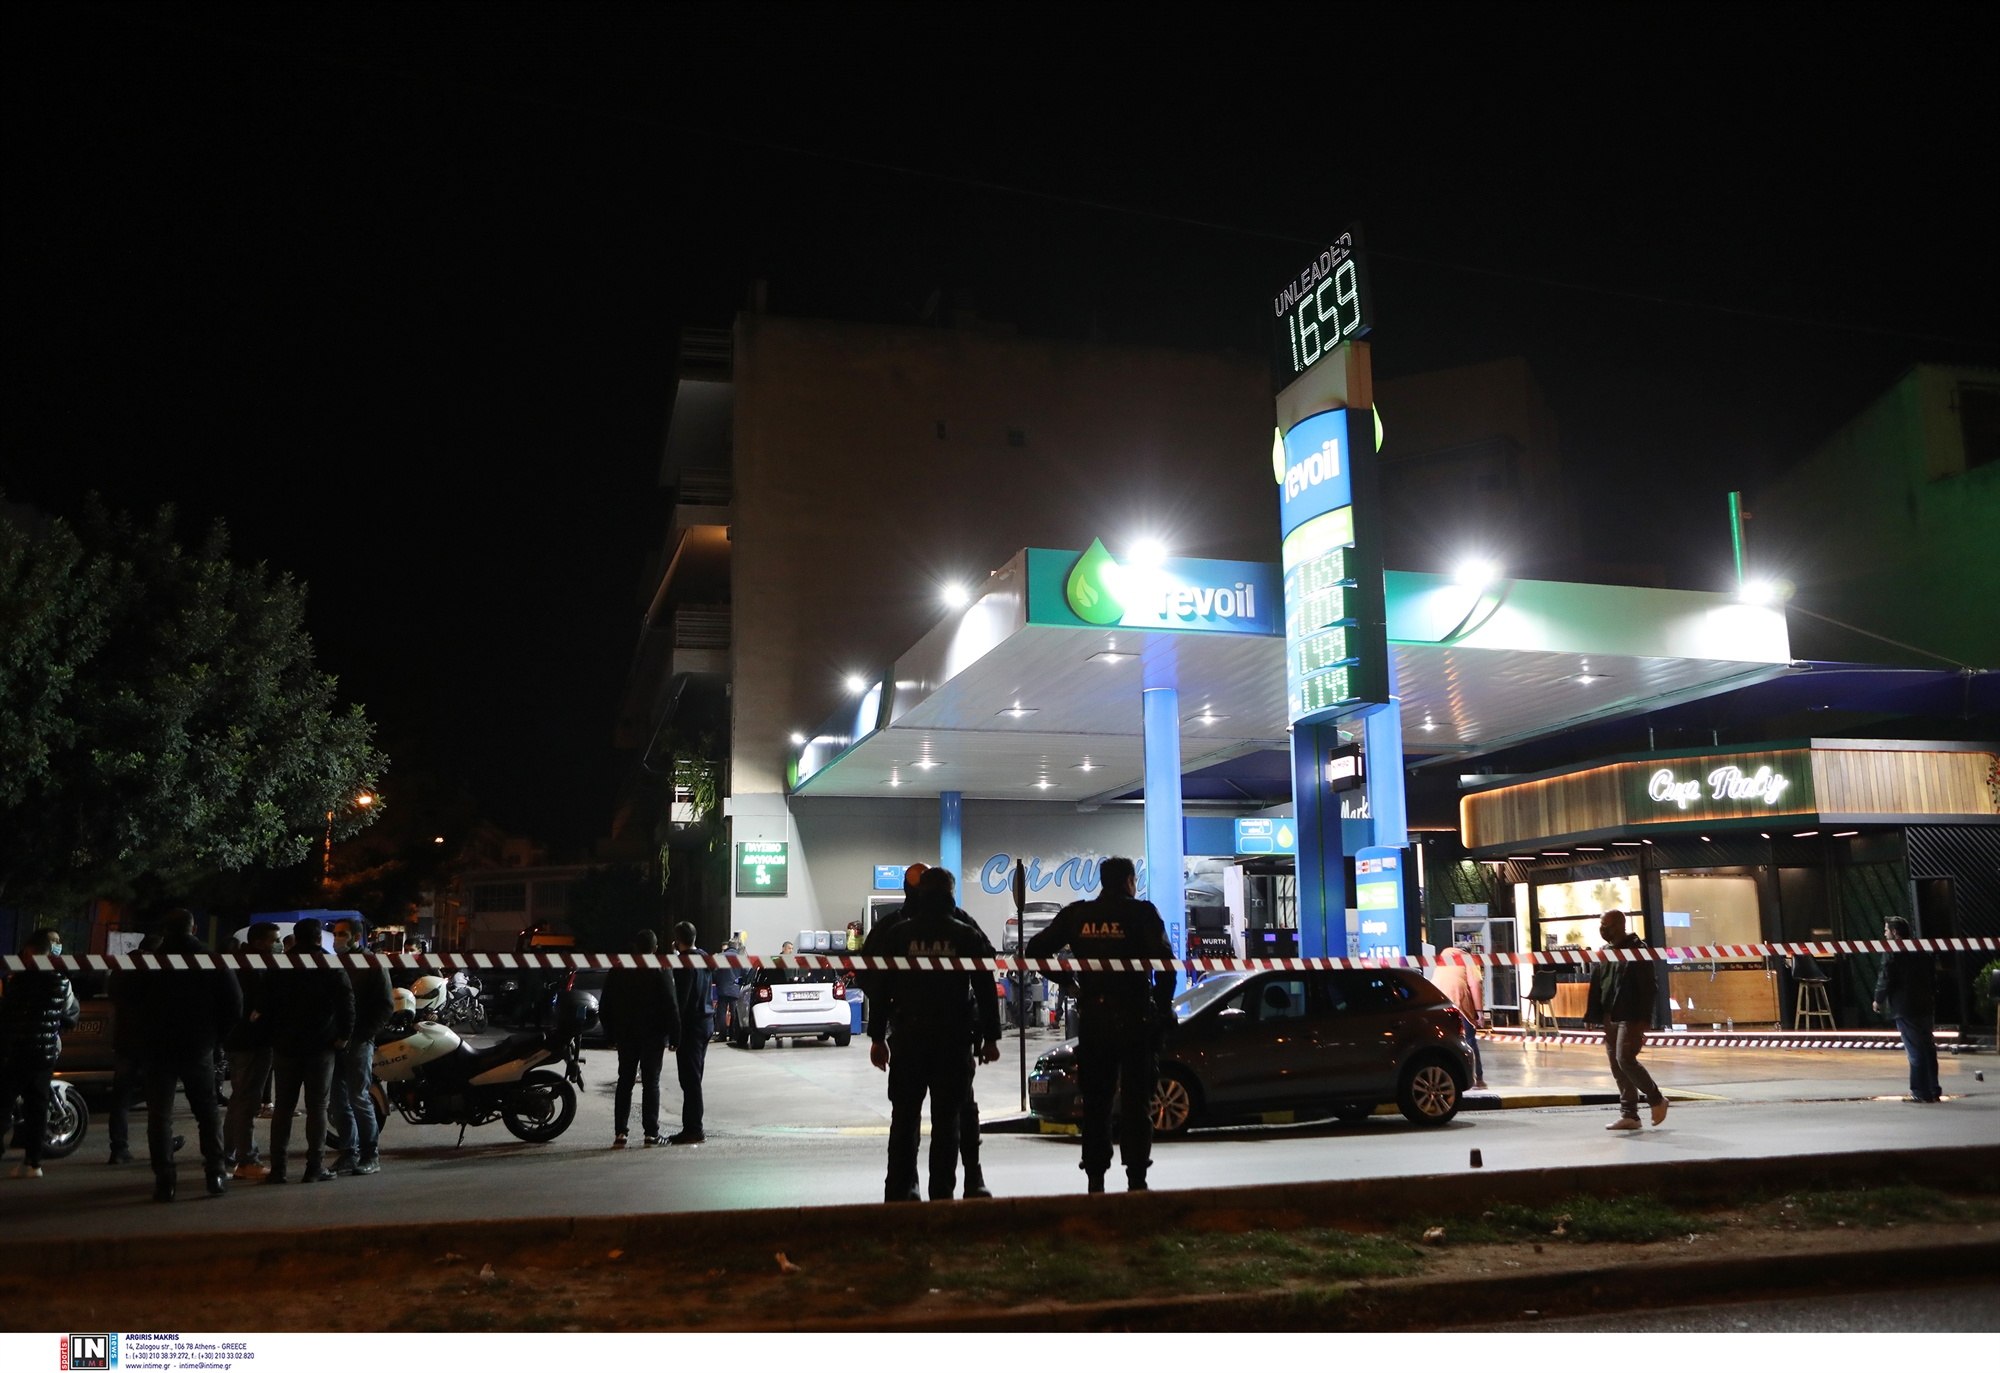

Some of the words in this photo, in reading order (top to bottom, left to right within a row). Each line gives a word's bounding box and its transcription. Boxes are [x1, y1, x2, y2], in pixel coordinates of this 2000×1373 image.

[1274, 232, 1351, 317] UNLEADED
[1285, 438, 1340, 503] revoil
[1341, 796, 1370, 819] Mark
[1649, 769, 1701, 809] Cup
[1708, 766, 1789, 805] Italy
[372, 1054, 409, 1068] POLICE
